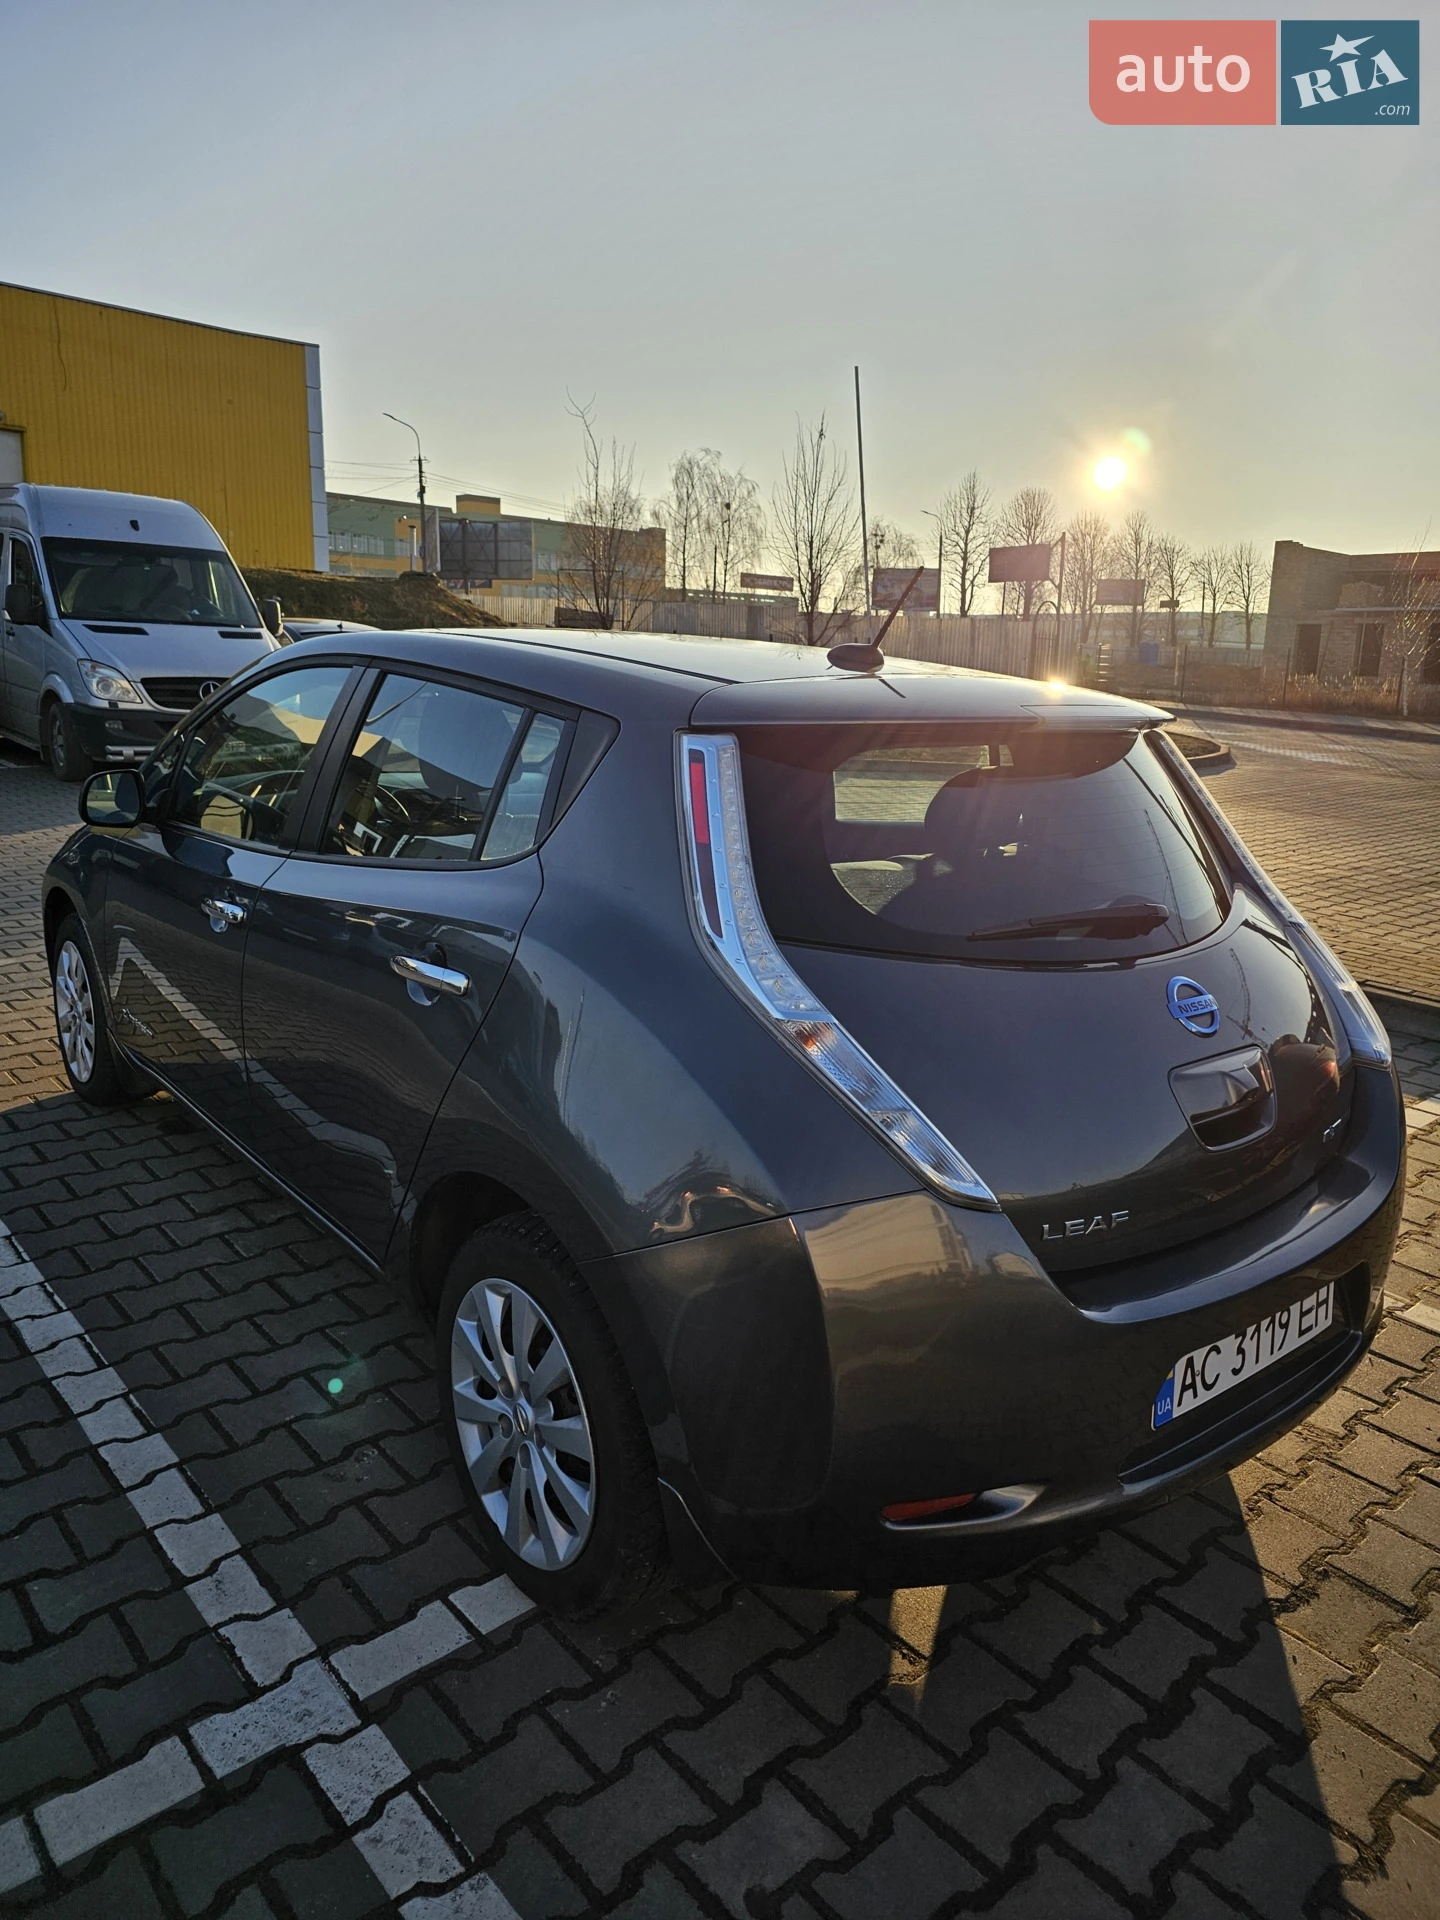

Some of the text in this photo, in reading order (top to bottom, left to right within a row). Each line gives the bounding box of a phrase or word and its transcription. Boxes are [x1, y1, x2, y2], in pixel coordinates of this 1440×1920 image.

[1177, 998, 1216, 1014] NISSAN
[1042, 1210, 1129, 1240] LEAF
[1176, 1285, 1330, 1407] AC 3119 EH
[1156, 1397, 1172, 1415] UA
